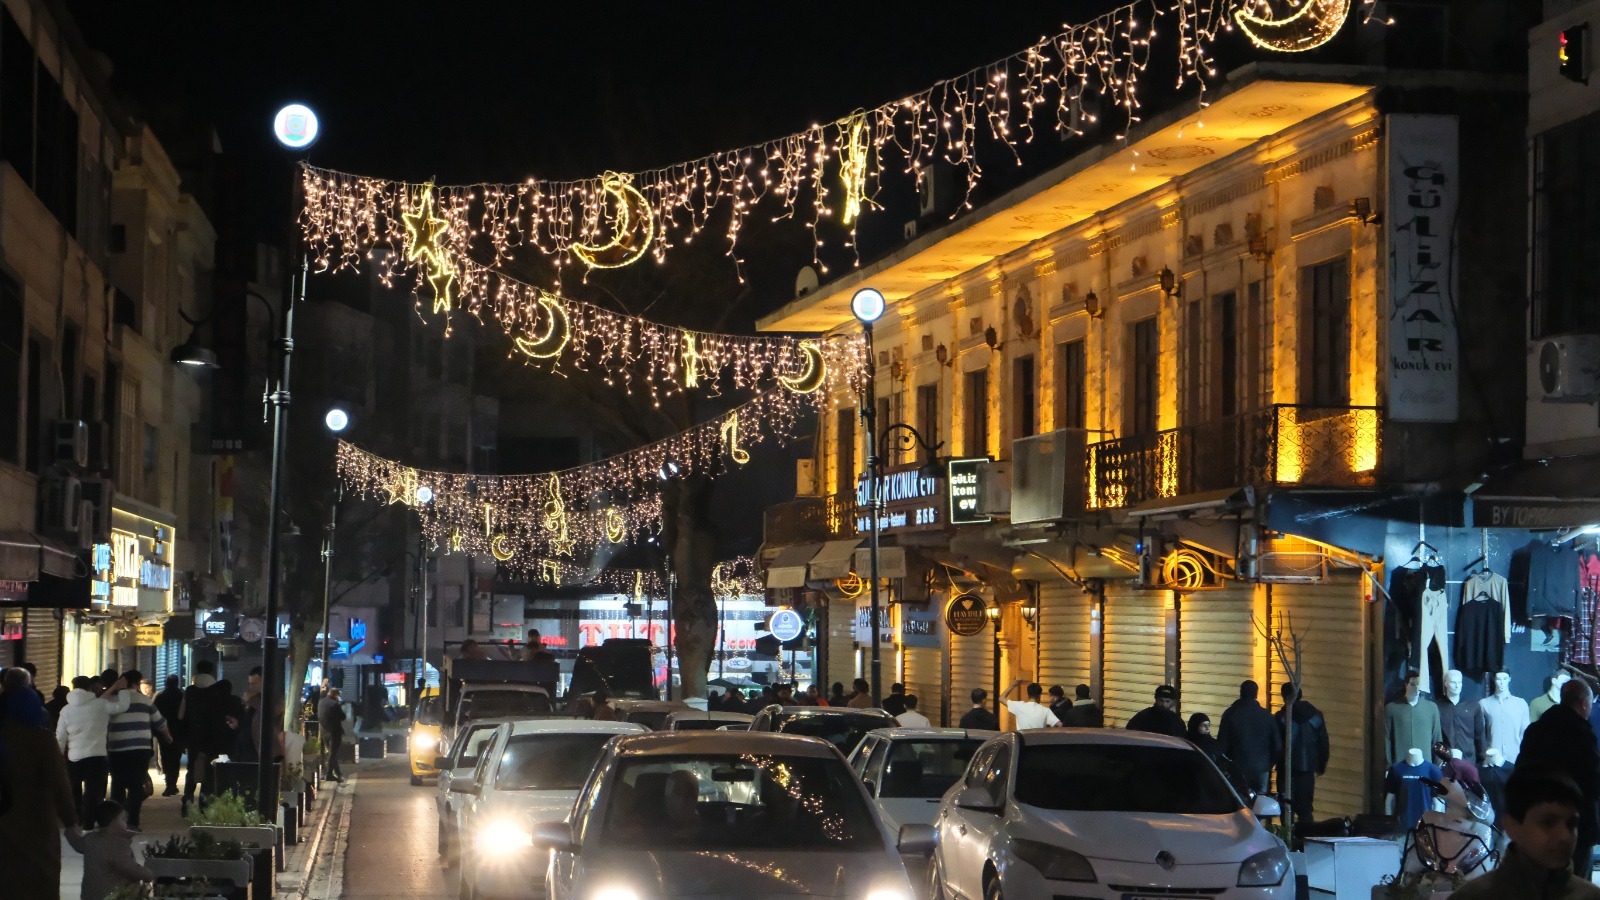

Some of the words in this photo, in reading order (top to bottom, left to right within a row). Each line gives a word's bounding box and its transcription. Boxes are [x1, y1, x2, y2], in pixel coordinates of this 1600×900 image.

[891, 470, 919, 500] KONUK
[951, 472, 977, 485] GÜLİZ
[1492, 505, 1510, 525] BY
